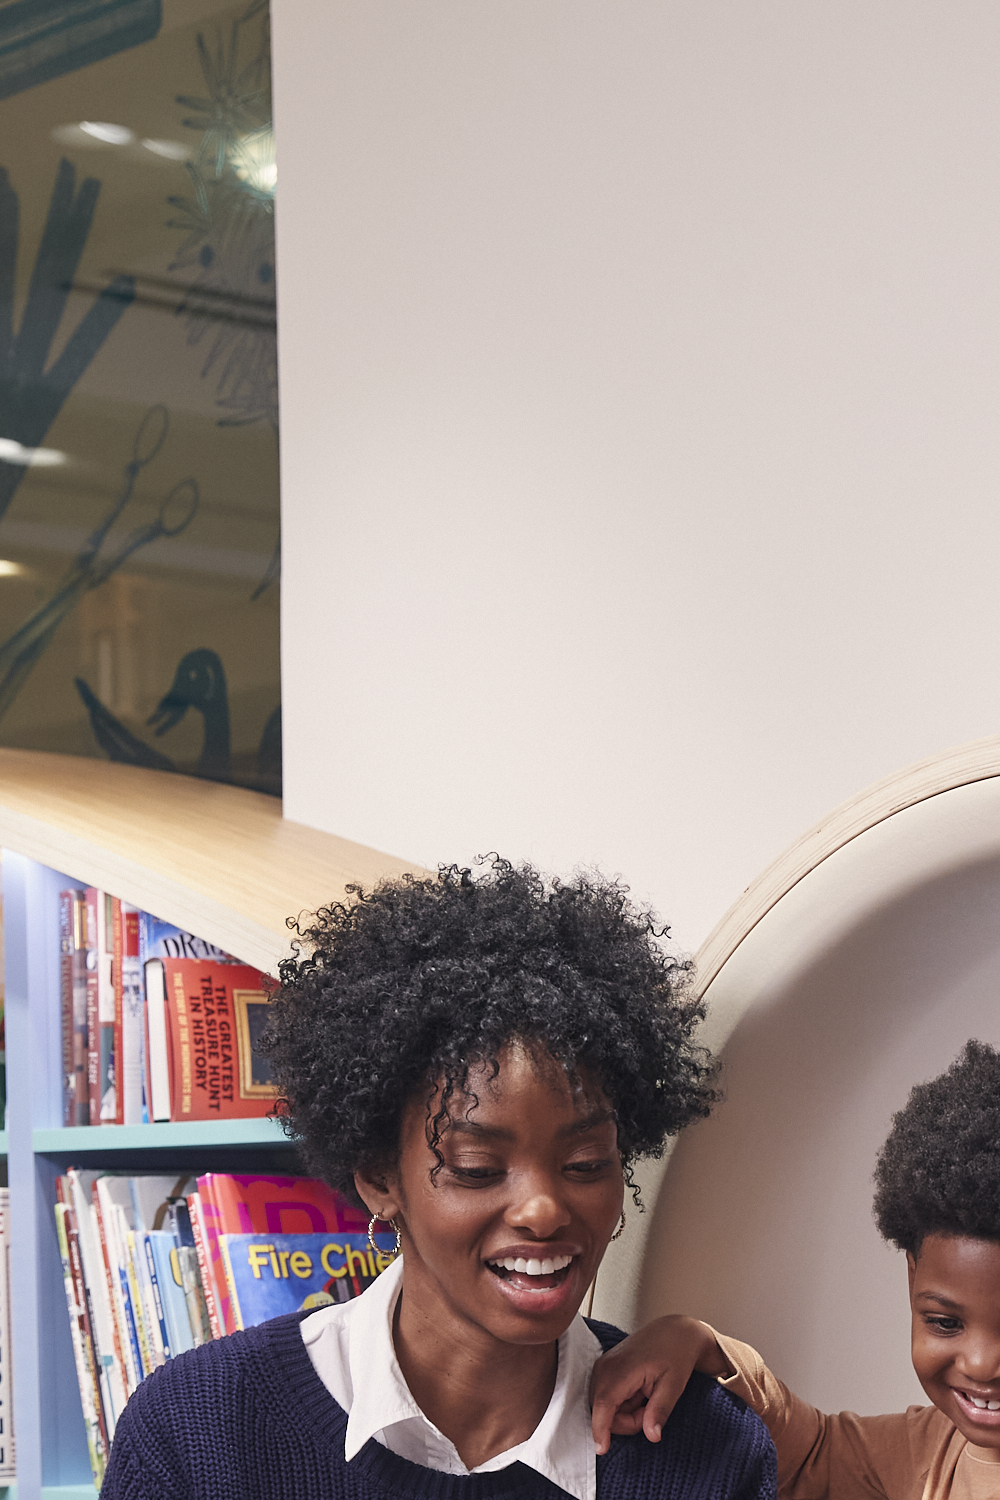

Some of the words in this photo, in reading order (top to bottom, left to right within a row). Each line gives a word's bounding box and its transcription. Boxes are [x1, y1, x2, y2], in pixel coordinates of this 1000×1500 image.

[173, 972, 184, 988] THE
[189, 996, 201, 1013] IN
[214, 986, 229, 1016] THE
[178, 1015, 188, 1026] OF
[200, 976, 219, 1060] TREASURE
[179, 1028, 189, 1043] THE
[193, 1020, 207, 1090] HISTORY
[219, 1020, 234, 1102] GREATEST
[209, 1065, 220, 1112] HUNT
[182, 1096, 191, 1114] MEN
[188, 1203, 197, 1223] The
[192, 1224, 201, 1242] Girl
[196, 1242, 206, 1266] Who
[248, 1244, 313, 1279] Fire
[320, 1243, 395, 1279] Chie
[201, 1266, 211, 1295] Heard
[206, 1296, 214, 1314] the
